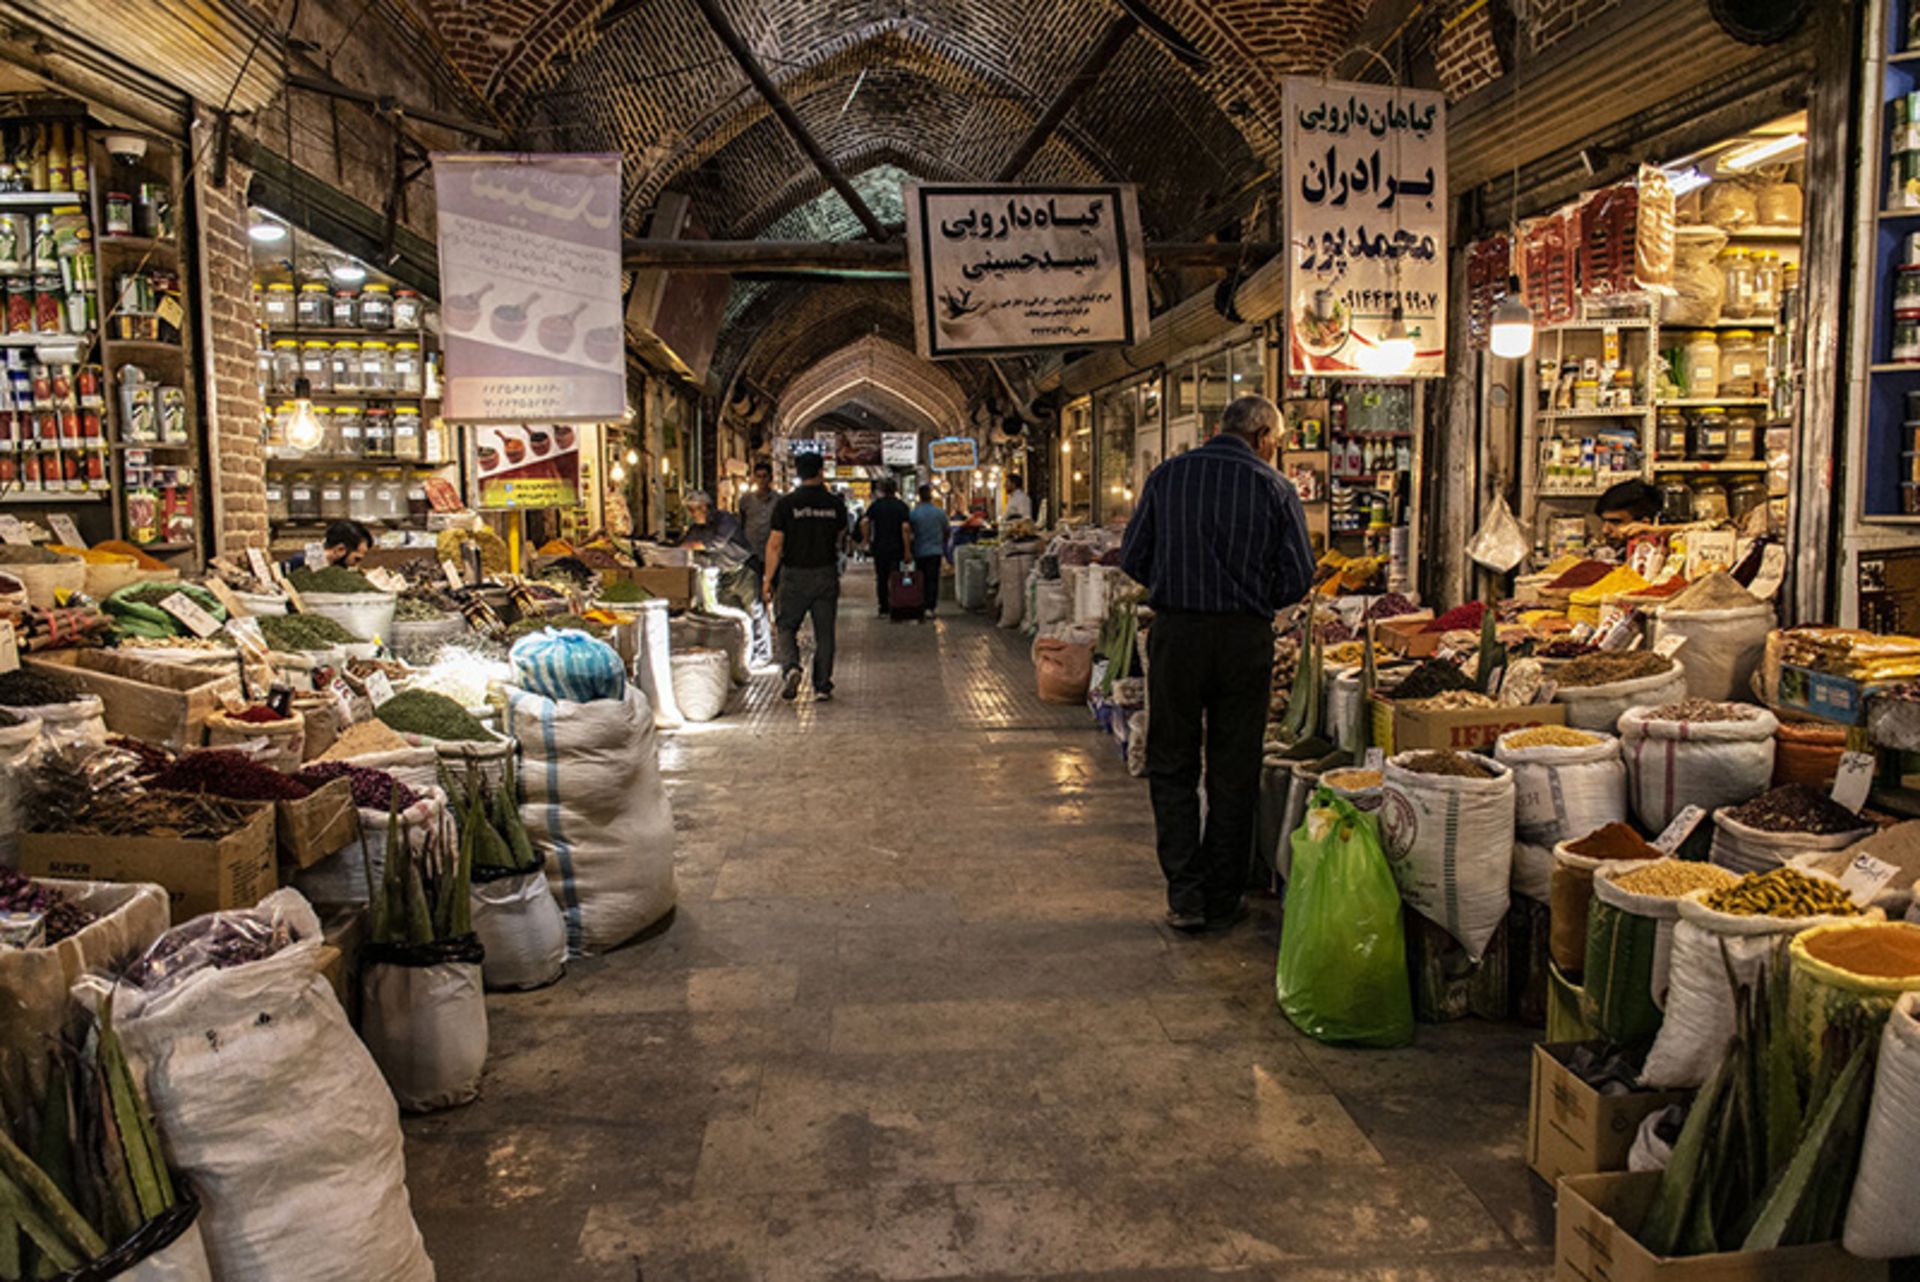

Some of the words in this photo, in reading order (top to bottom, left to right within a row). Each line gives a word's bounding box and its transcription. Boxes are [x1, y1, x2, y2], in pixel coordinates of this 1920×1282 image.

[1299, 96, 1368, 132] دارویی
[1301, 144, 1436, 213] برادران
[941, 199, 1032, 238] دارویی
[962, 251, 1037, 279] حسینی
